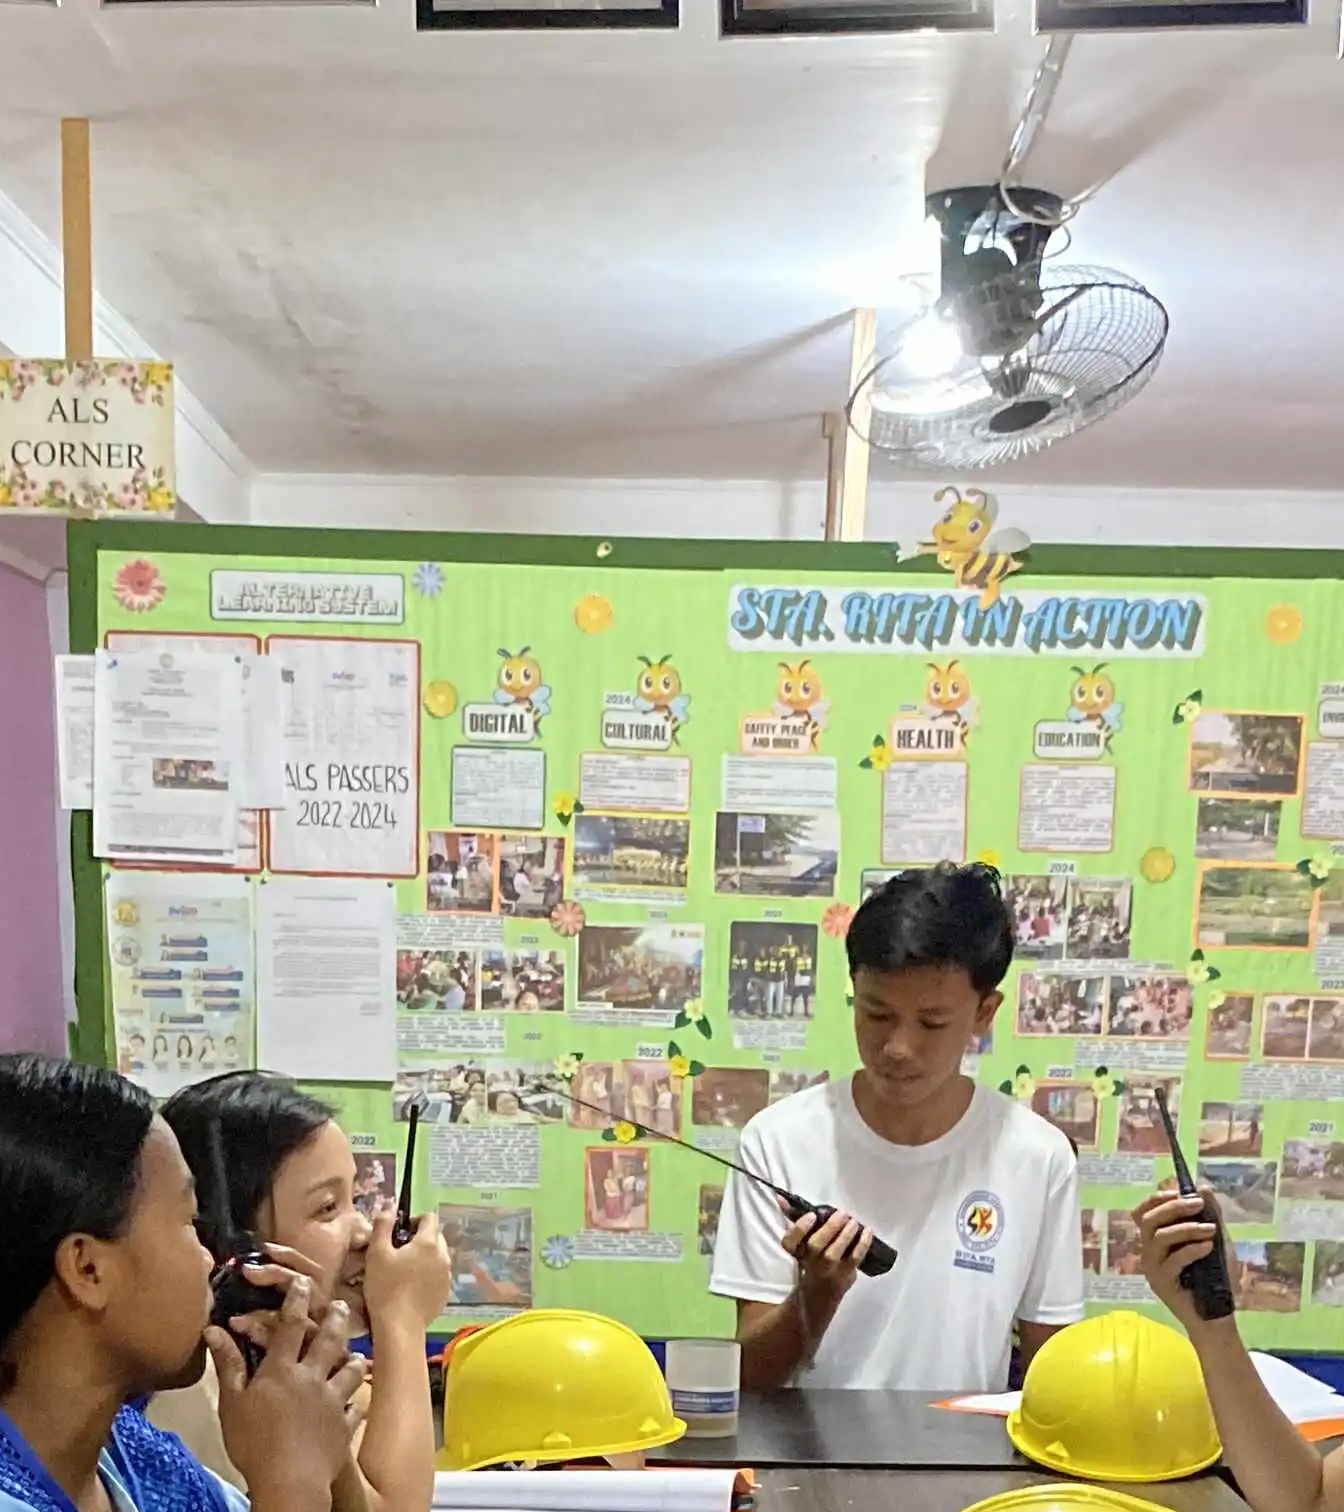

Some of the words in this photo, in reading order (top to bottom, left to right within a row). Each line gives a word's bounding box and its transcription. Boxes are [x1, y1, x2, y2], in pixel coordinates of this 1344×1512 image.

[47, 397, 110, 424] ALS
[10, 440, 146, 470] CORNER
[241, 582, 374, 601] ALTERNATIVE
[218, 595, 316, 613] LEARNING
[319, 599, 399, 617] SYSTEM
[730, 587, 836, 647] STA.
[841, 591, 959, 651] RITA
[958, 595, 1024, 647] IN
[1023, 597, 1203, 654] ACTION
[605, 693, 632, 704] 2024
[469, 711, 528, 734] DIGITAL
[604, 721, 669, 743] CULTURAL
[896, 728, 955, 750] HEALTH
[1037, 732, 1101, 748] EDUCATION
[284, 761, 318, 791] ALS
[327, 763, 409, 794] PASSERS
[638, 1046, 664, 1058] 2022
